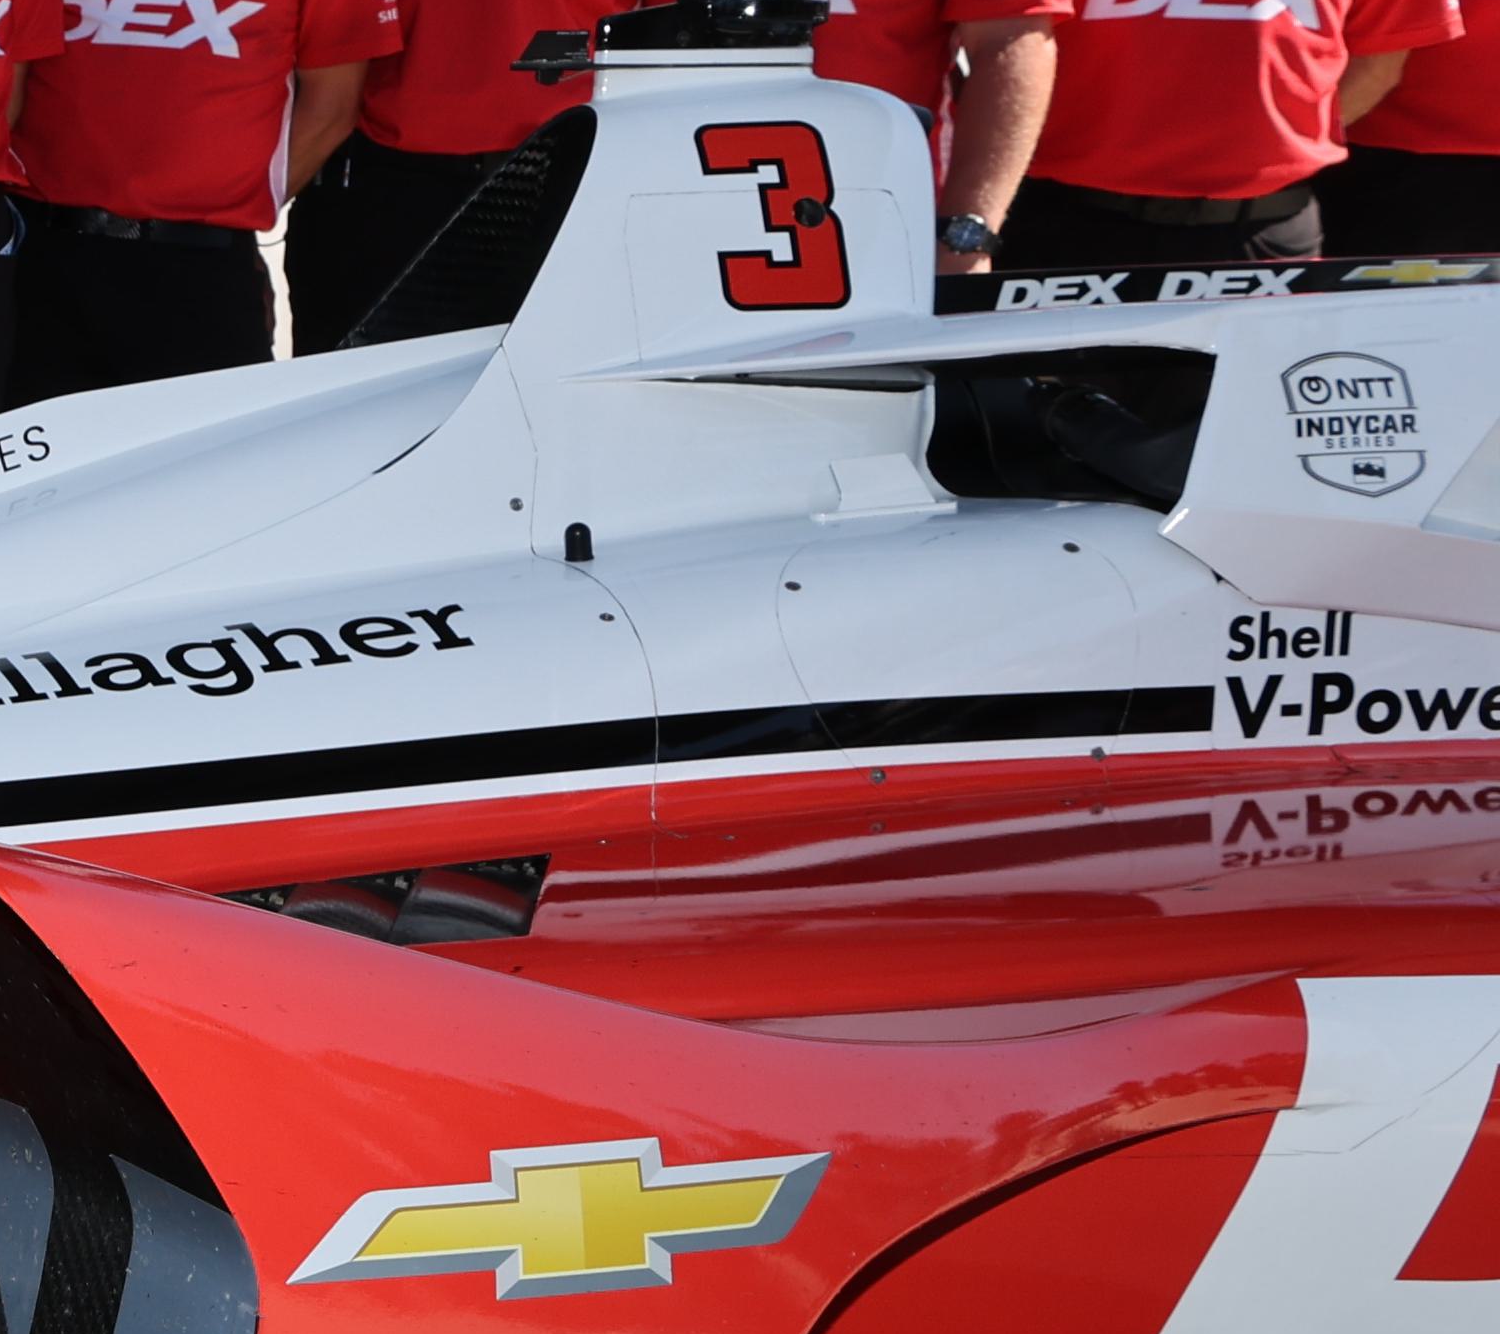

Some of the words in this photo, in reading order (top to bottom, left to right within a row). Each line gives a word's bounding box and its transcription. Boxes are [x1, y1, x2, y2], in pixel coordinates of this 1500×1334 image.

[693, 120, 852, 312] 3
[994, 270, 1132, 313] DEX
[1155, 266, 1307, 304] DEX
[1337, 375, 1396, 401] NTT
[1293, 413, 1421, 439] INDYCAR
[1323, 434, 1397, 451] SERIES
[1226, 609, 1354, 662] Shell
